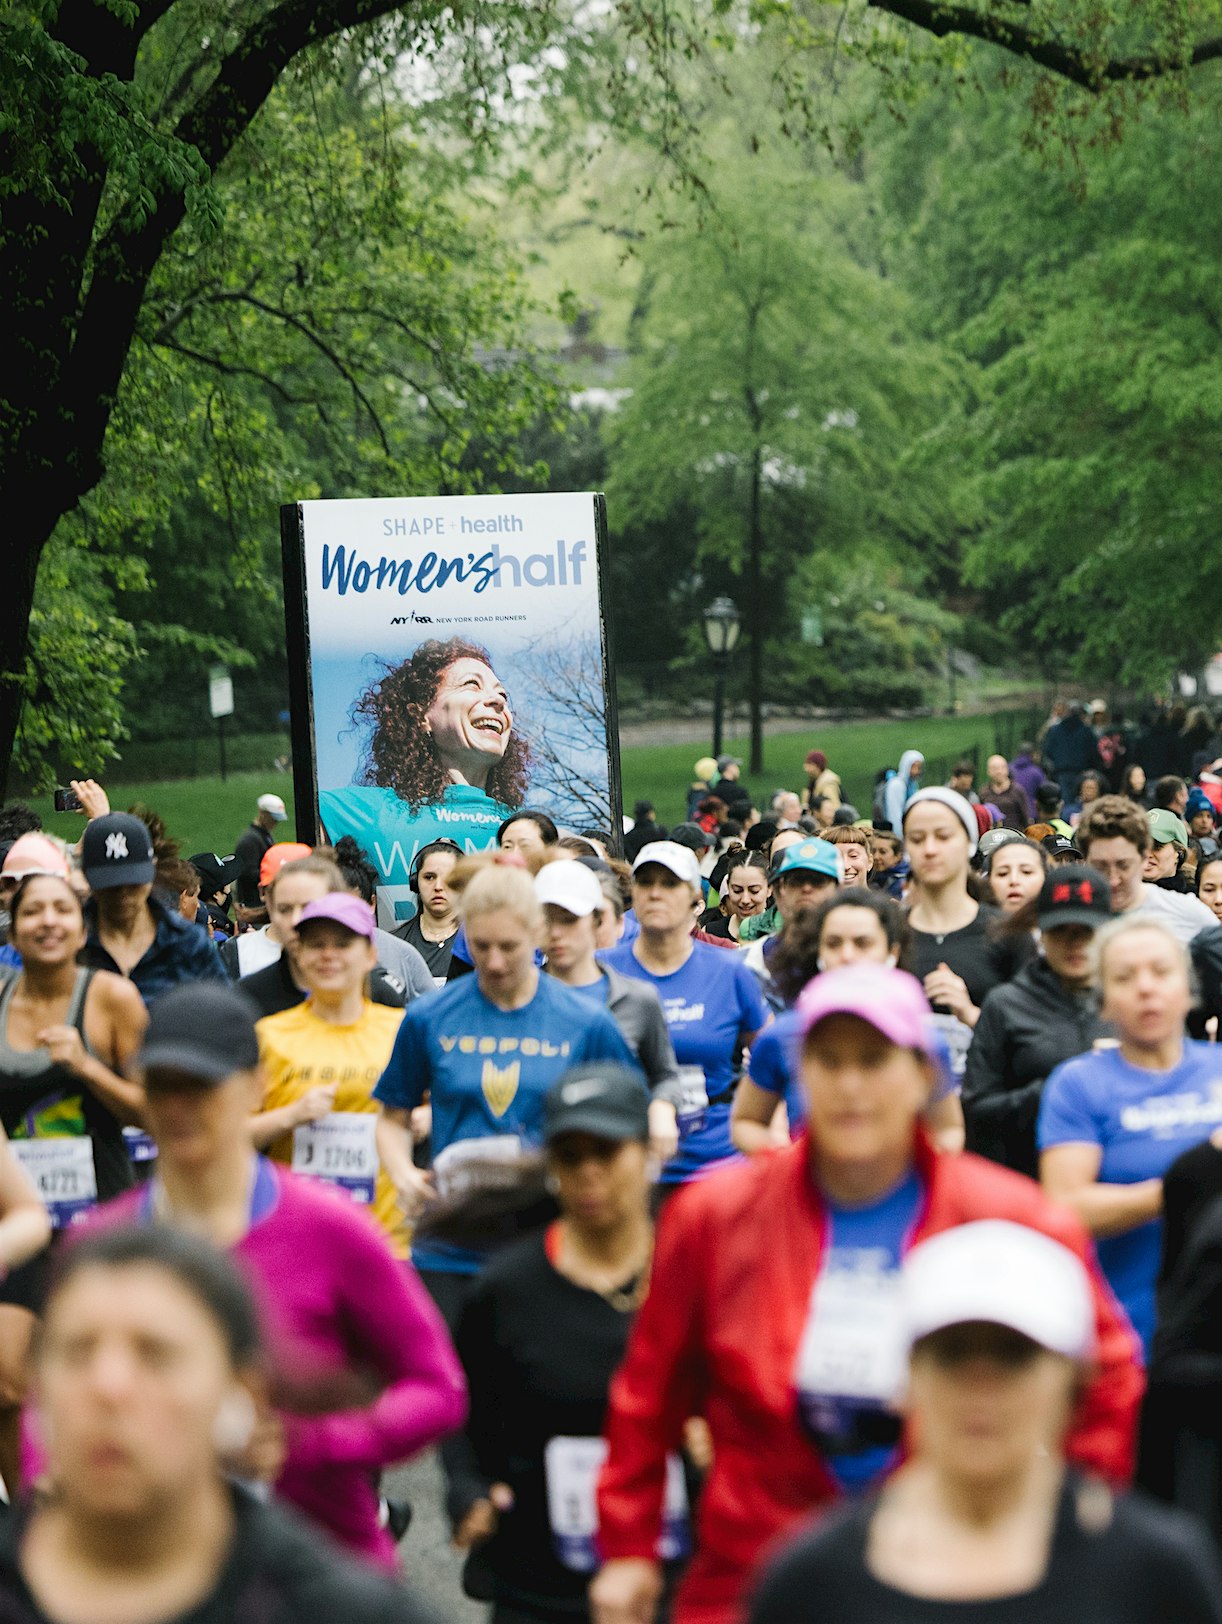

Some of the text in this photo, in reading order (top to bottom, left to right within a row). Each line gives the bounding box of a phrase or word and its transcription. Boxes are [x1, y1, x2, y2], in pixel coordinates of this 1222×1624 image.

[383, 517, 445, 536] SHAPE
[460, 514, 523, 533] health
[322, 540, 587, 595] Women's half
